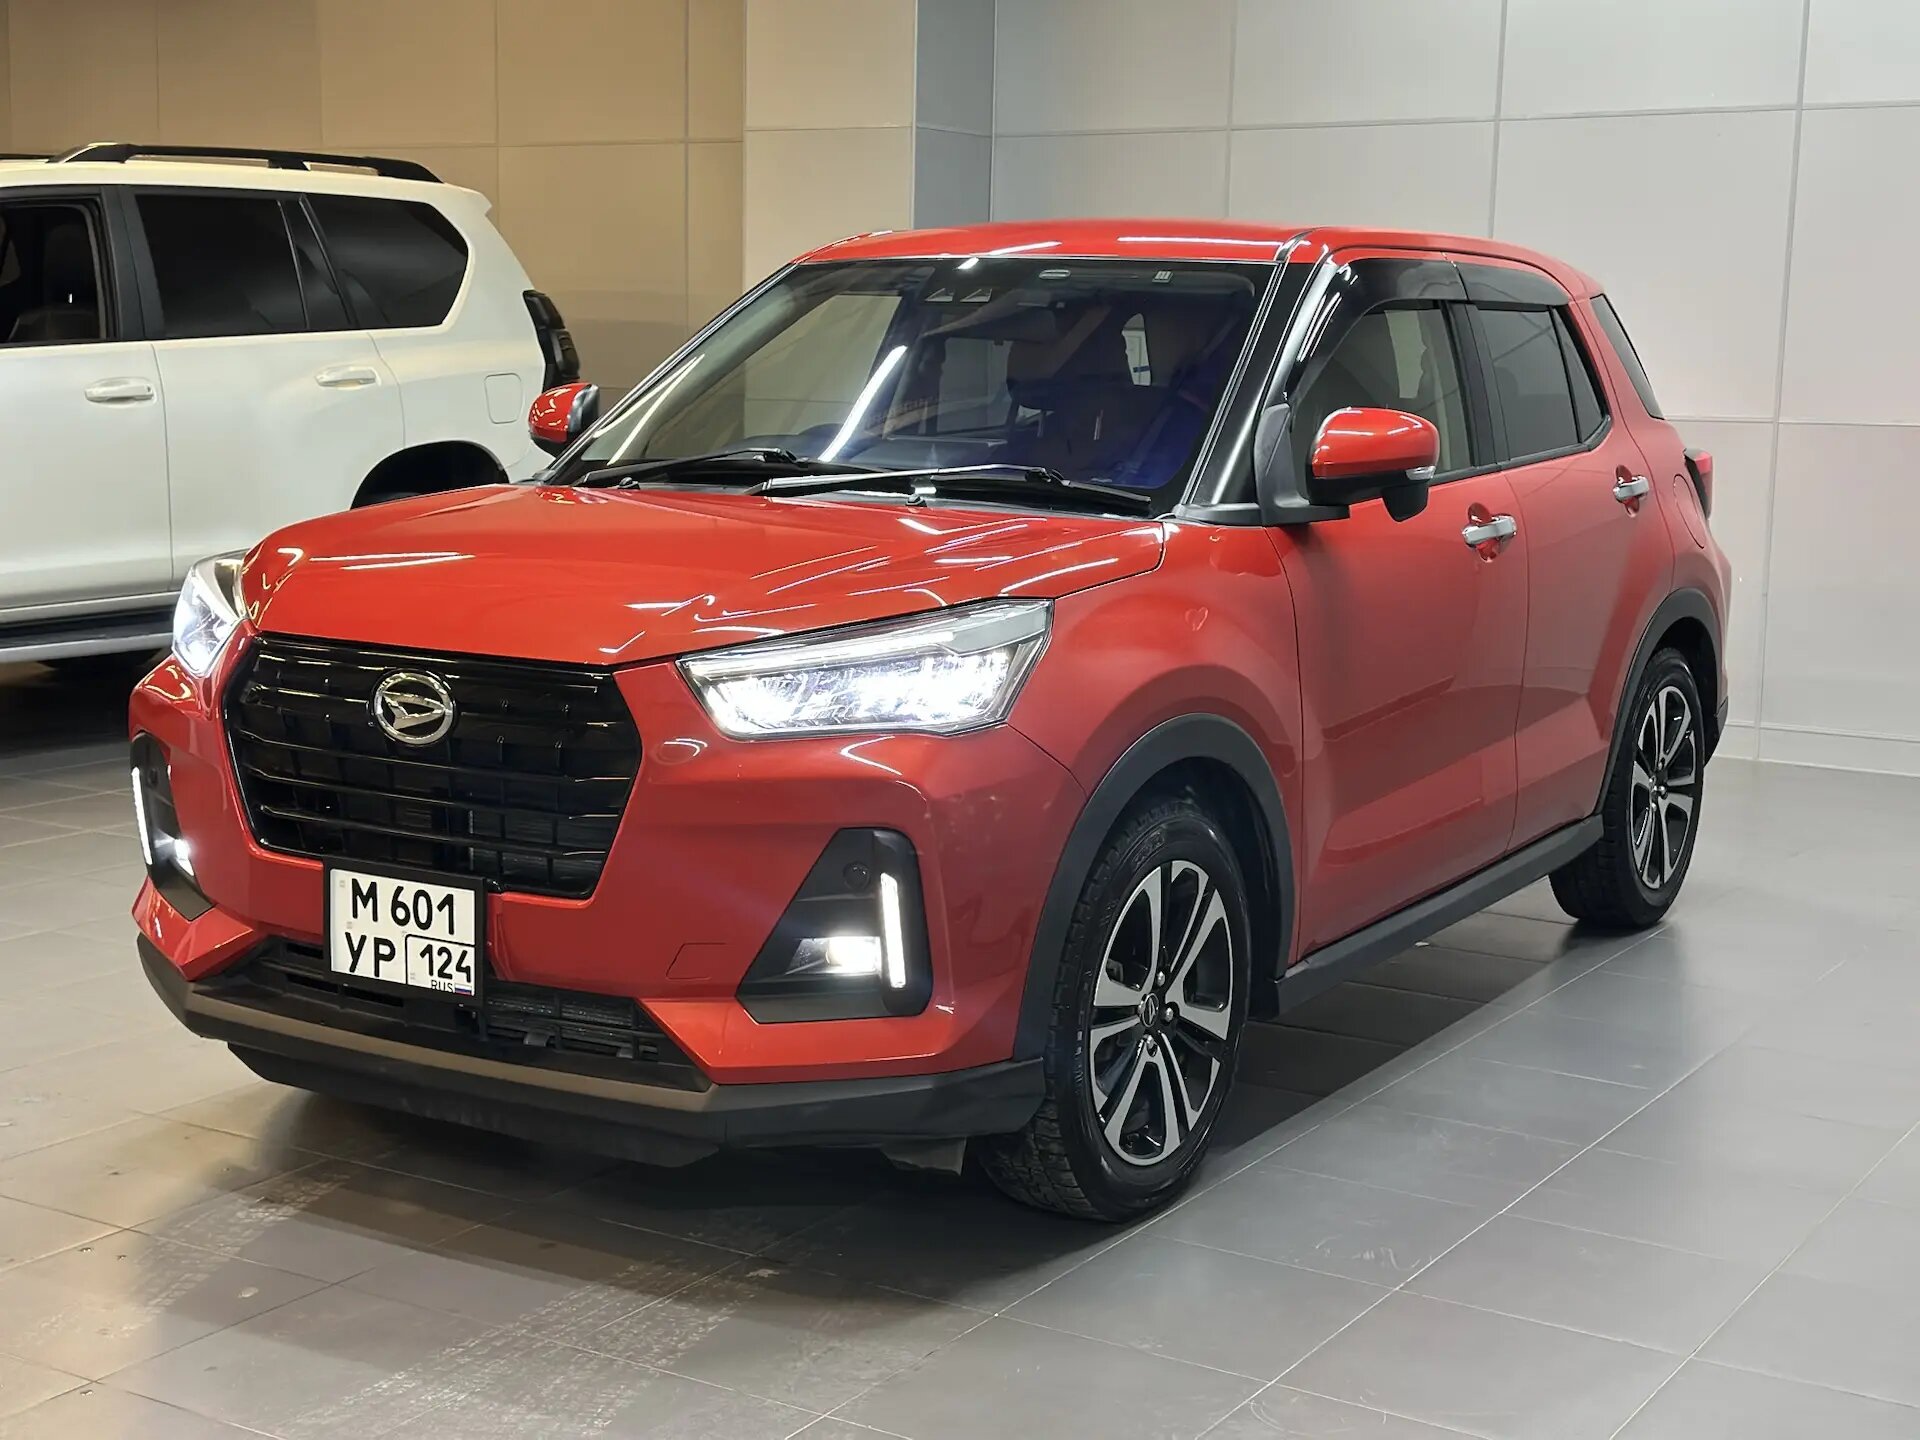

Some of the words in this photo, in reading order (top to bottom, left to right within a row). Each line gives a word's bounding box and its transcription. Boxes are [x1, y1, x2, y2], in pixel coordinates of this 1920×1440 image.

[390, 885, 455, 935] 601
[419, 943, 472, 984] 124
[431, 979, 453, 993] RUS
